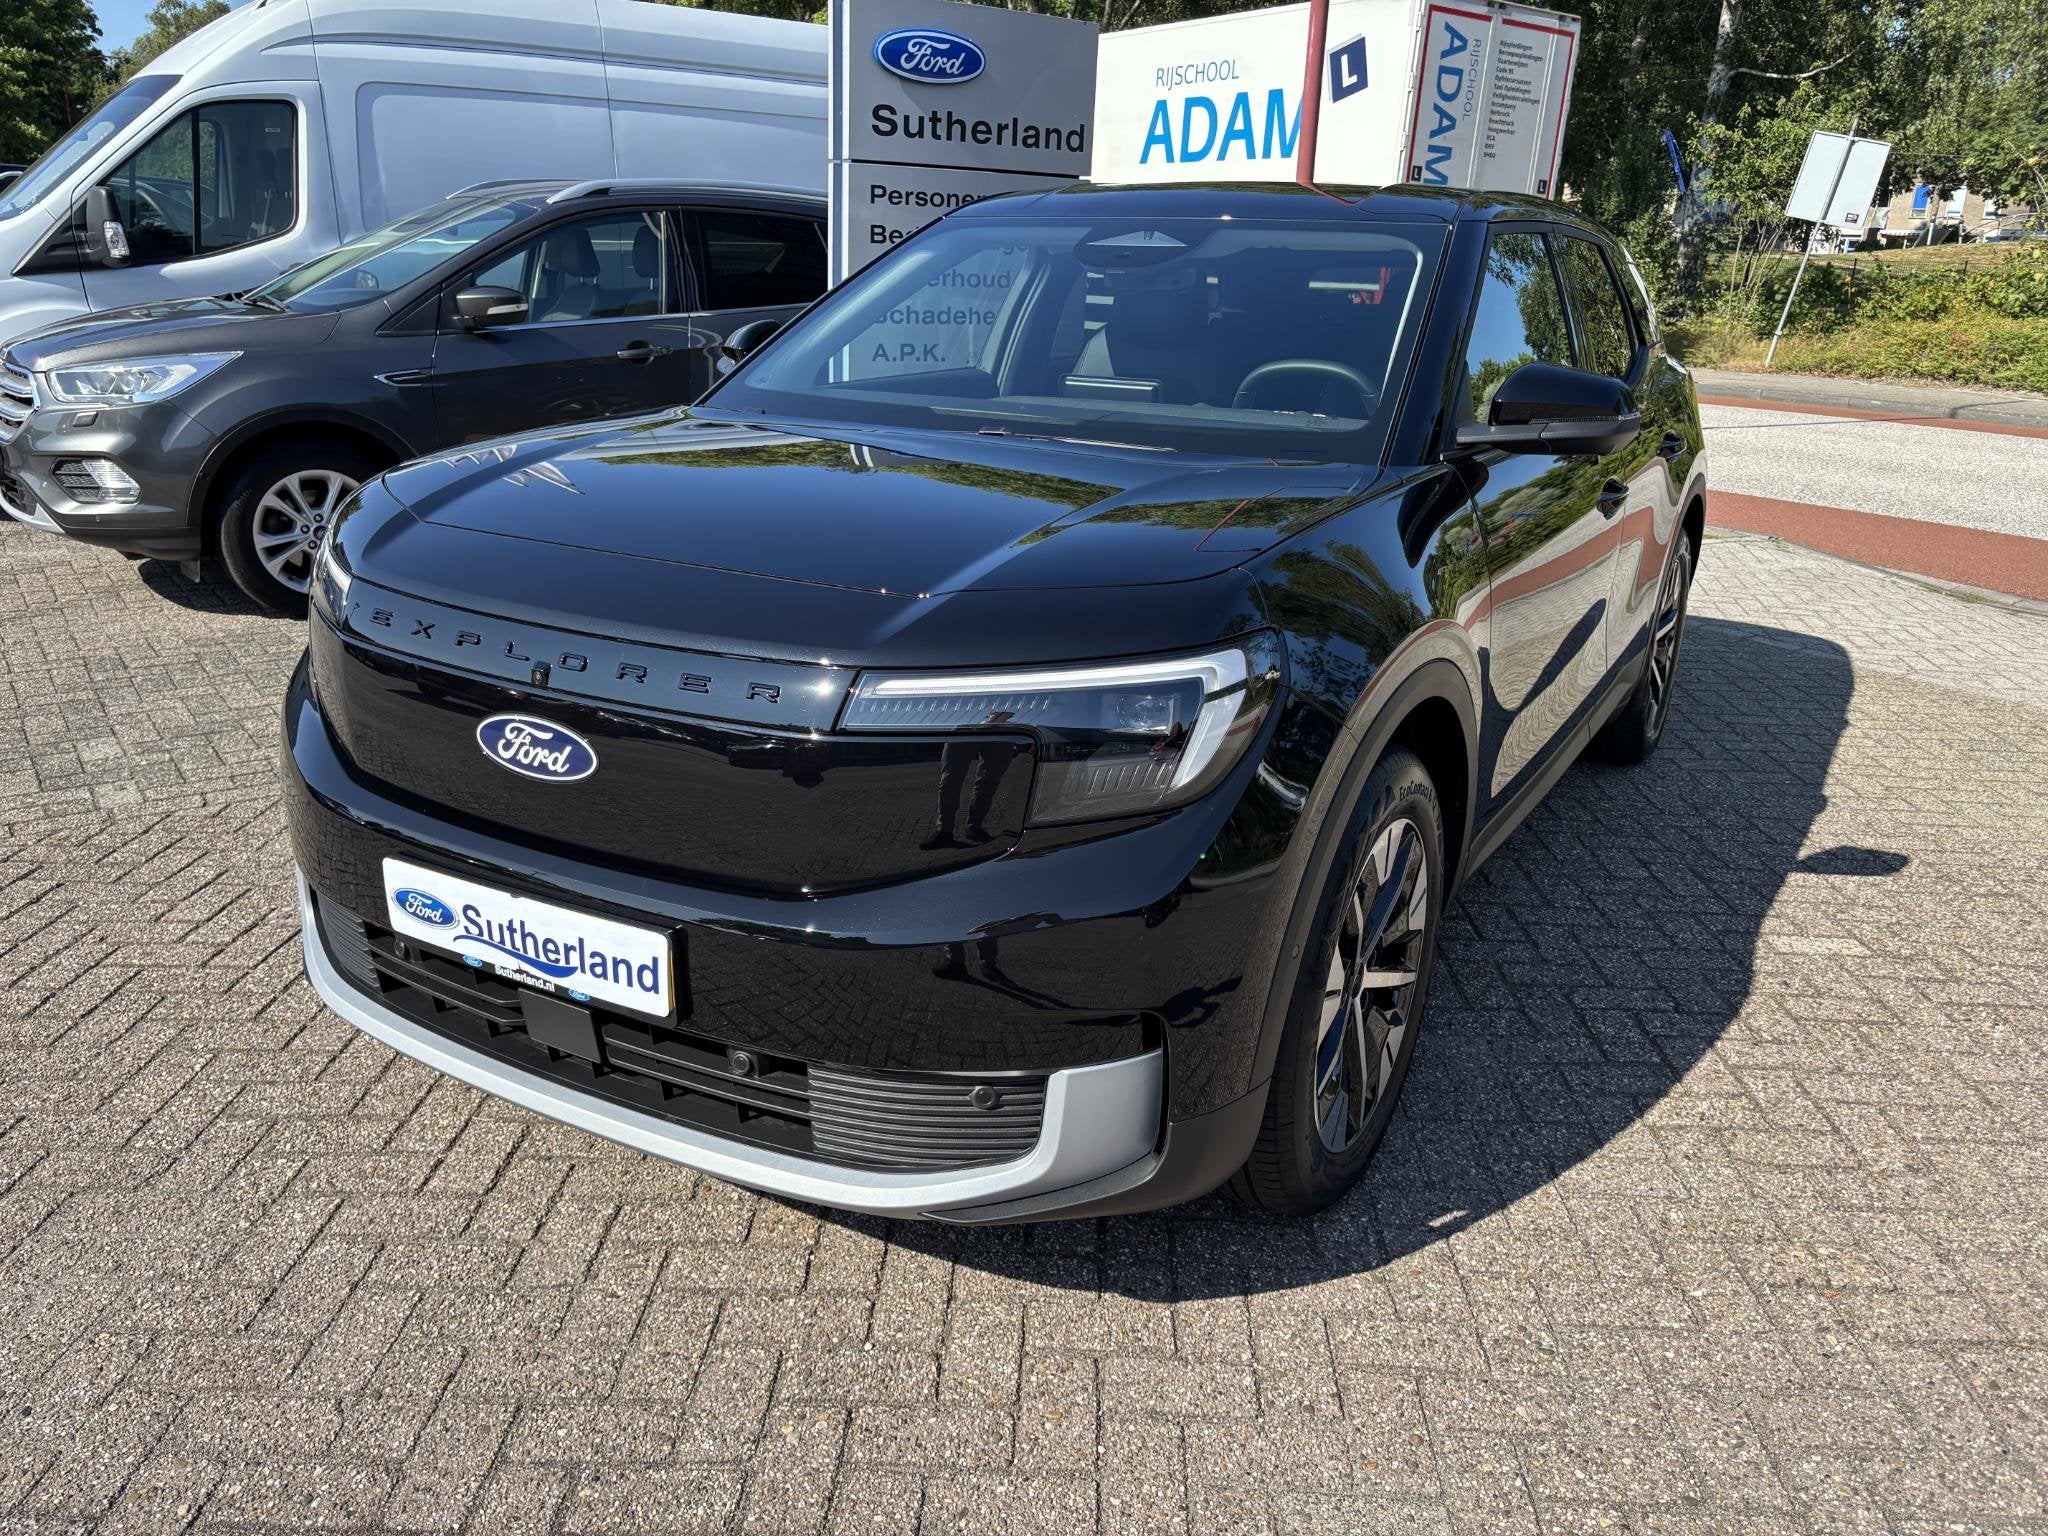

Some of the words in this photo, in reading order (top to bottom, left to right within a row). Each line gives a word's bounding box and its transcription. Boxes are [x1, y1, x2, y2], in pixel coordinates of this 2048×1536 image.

[1156, 59, 1240, 91] RIJSCHOOL
[1340, 53, 1358, 89] L
[1462, 38, 1482, 122] RIJSCHOOL
[1494, 83, 1504, 91] Taxi
[1422, 21, 1469, 186] ADAM
[871, 103, 1085, 153] Sutherland
[1139, 88, 1304, 165] ADAM
[869, 184, 987, 208] Persone
[872, 343, 946, 362] A.P.K.
[369, 607, 783, 705] EXPLORER
[461, 903, 661, 995] Sutherland
[494, 963, 556, 993] Sutherland.nl
